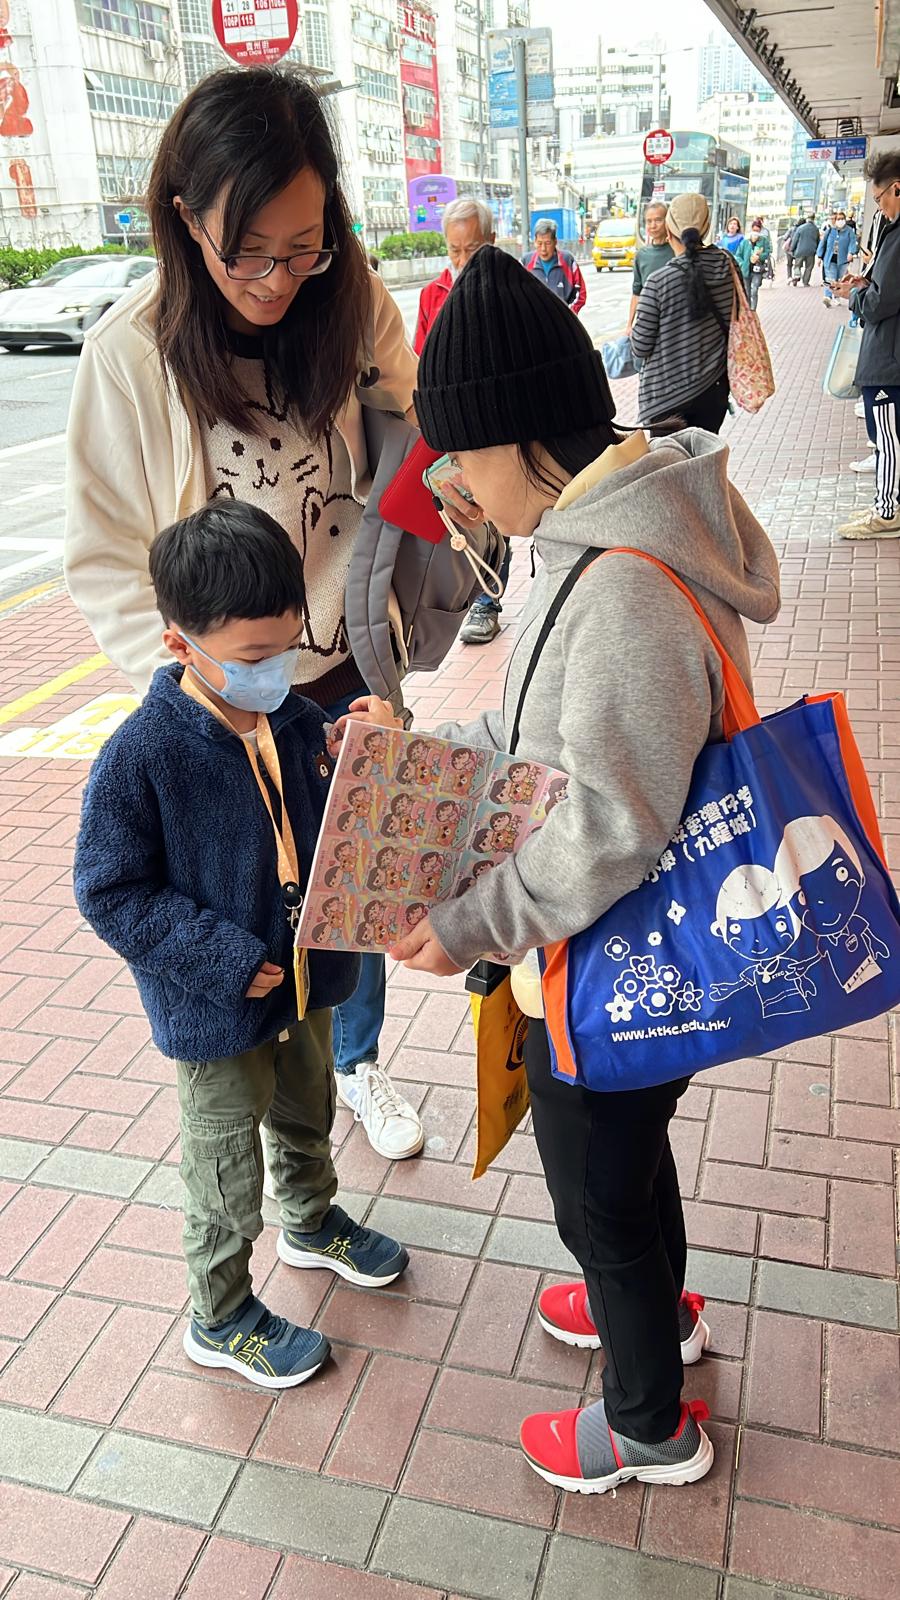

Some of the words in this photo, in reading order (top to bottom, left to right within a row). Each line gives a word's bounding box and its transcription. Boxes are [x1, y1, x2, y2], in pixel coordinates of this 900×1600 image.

[226, 3, 234, 12] 21
[242, 1, 250, 10] 28
[241, 14, 253, 26] 115
[16, 730, 109, 755] 115
[611, 1017, 732, 1042] www.ktkc.edu.hk/
